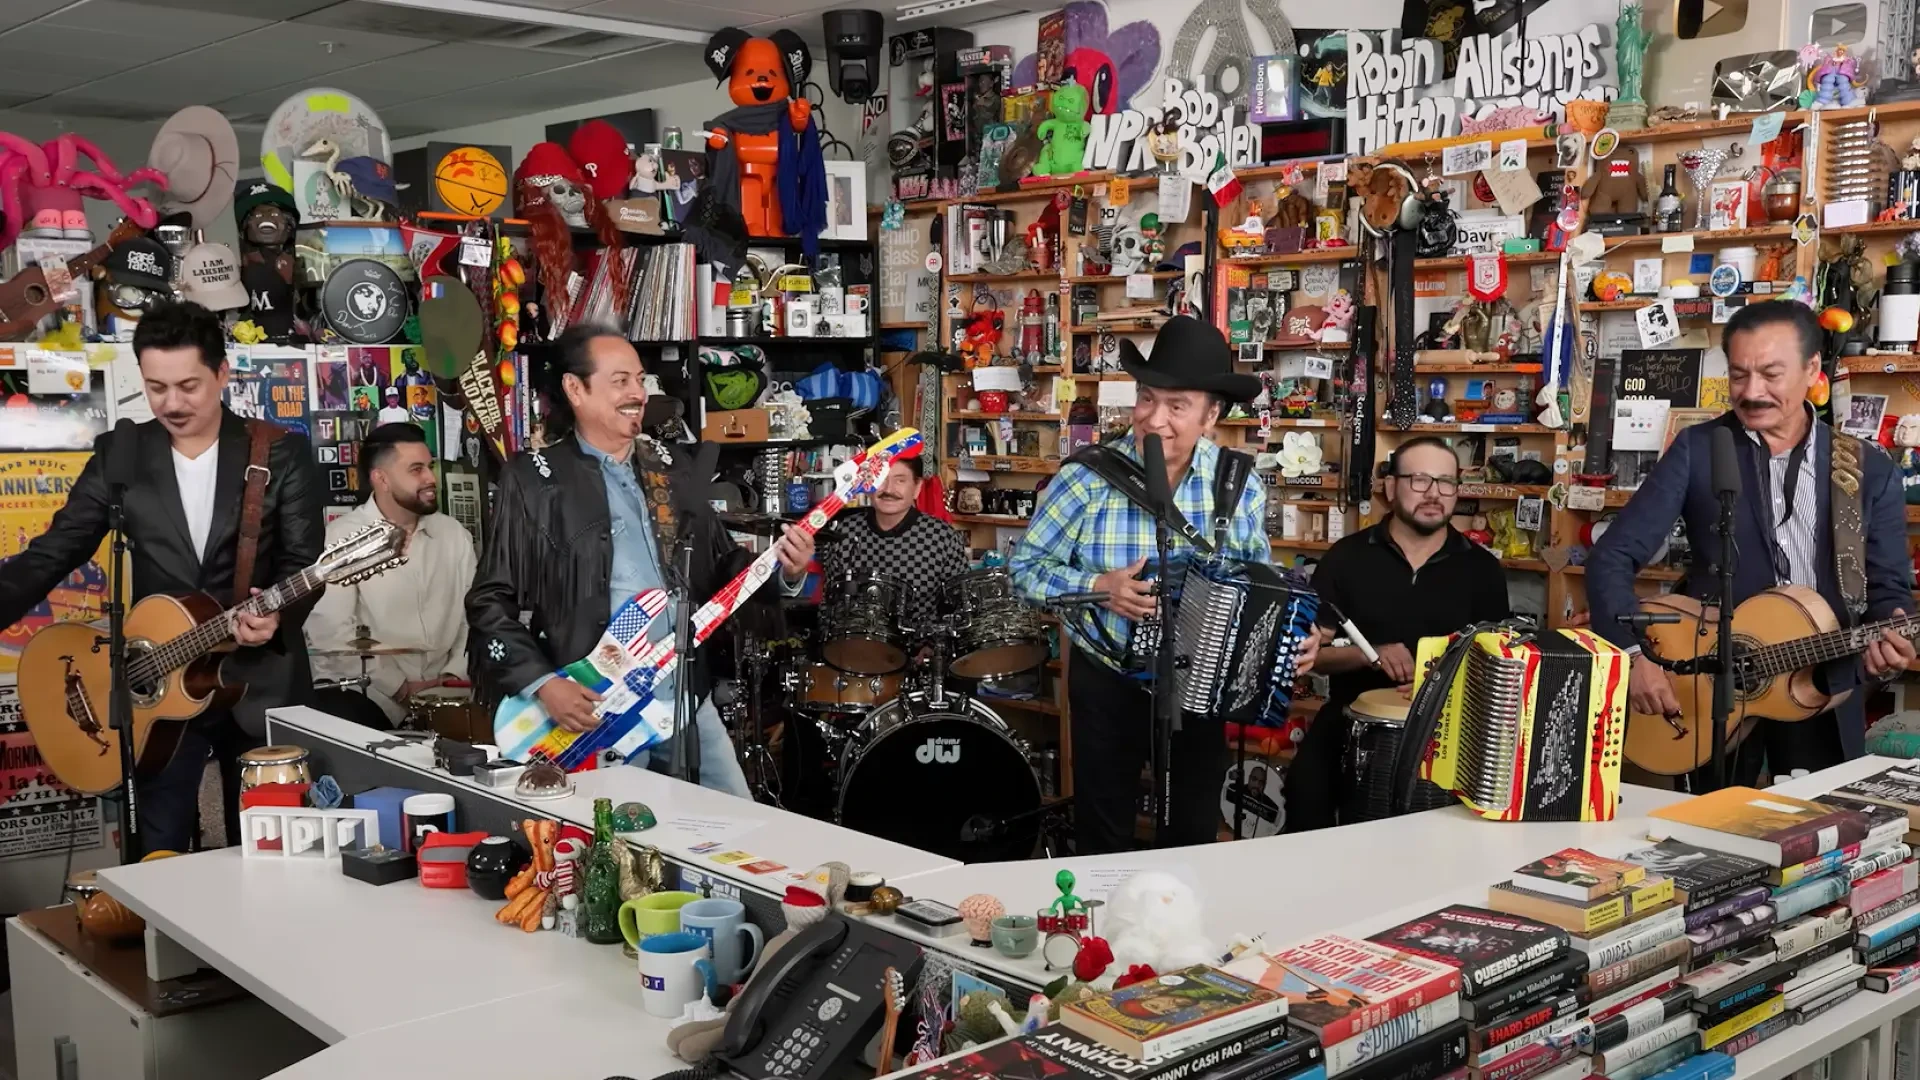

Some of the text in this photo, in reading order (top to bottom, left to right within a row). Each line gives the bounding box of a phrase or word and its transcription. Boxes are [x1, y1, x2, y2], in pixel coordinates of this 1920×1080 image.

[1347, 29, 1436, 98] Robin
[1454, 23, 1602, 100] Allsongs
[1164, 74, 1219, 126] Bob
[1254, 62, 1265, 115] HwaBoon
[864, 96, 885, 115] NO
[1083, 108, 1163, 171] NPR
[1347, 96, 1455, 156] Hilton
[209, 259, 224, 267] AM
[879, 249, 919, 266] Glass
[192, 266, 234, 277] LAKSHMI
[201, 274, 230, 284] SINGH
[271, 385, 305, 401] ON THE
[1624, 378, 1646, 392] GOD
[277, 402, 303, 418] ROAD
[471, 394, 496, 434] MAGIC
[485, 396, 503, 427] GIRL
[1353, 395, 1367, 446] Rodgers
[319, 416, 370, 441] TINY
[1, 460, 67, 473] NPR MUSIC
[916, 738, 961, 764] dw
[935, 737, 961, 745] drums
[9, 775, 29, 790] la
[32, 812, 70, 827] OPEN
[88, 809, 96, 820] 7
[252, 815, 363, 853] npr
[1299, 938, 1374, 965] MUSIC
[1474, 954, 1518, 984] QUEENS
[1518, 953, 1527, 962] of
[1526, 936, 1559, 959] NOISE
[1599, 940, 1632, 967] VOICES
[1274, 948, 1405, 994] HOW WOMEN
[1361, 958, 1432, 982] MADE
[1495, 1015, 1524, 1040] HARD
[1524, 1007, 1554, 1029] STUFF
[1035, 1032, 1148, 1074] JOHNNY
[1059, 1054, 1106, 1078] RADHIKA
[1191, 1049, 1220, 1073] CASH
[1221, 1041, 1243, 1060] FAQ
